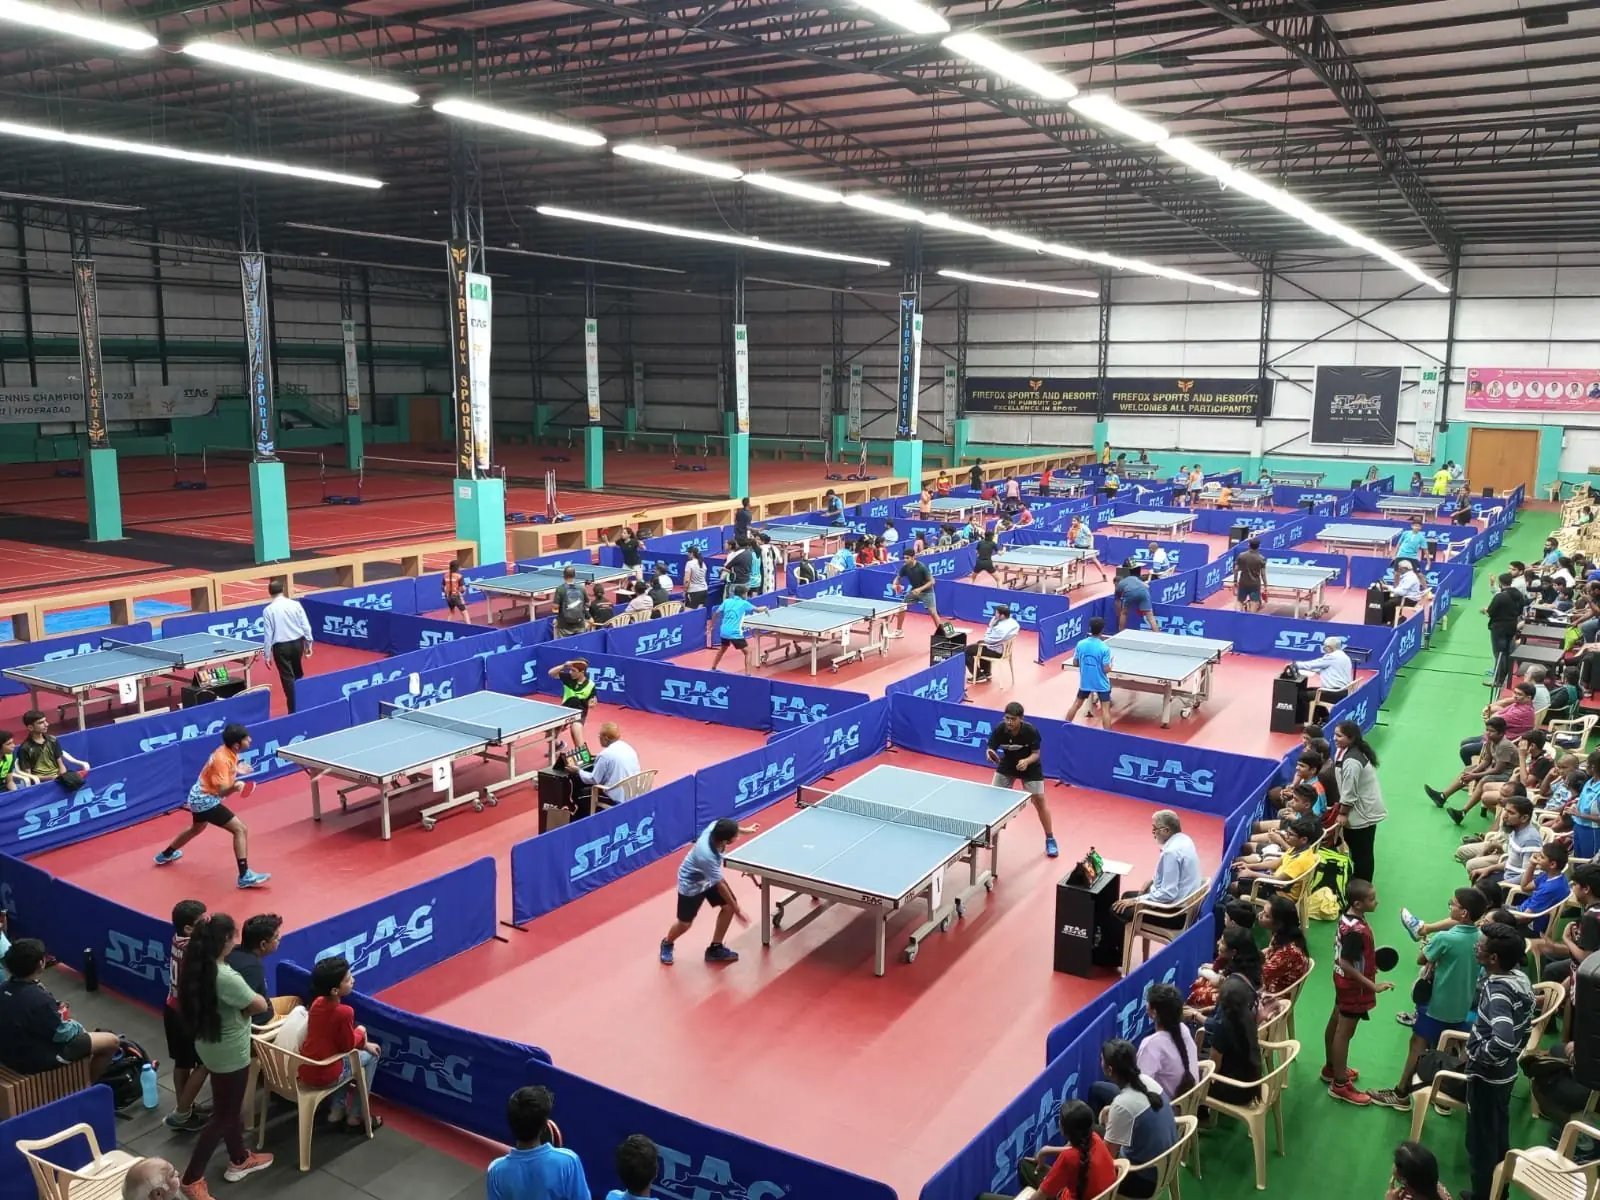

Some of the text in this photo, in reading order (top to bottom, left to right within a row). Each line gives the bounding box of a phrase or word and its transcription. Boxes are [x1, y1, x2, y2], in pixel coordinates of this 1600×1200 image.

[457, 270, 472, 454] FIREFOX SPORTS
[0, 394, 30, 402] ENNIS
[89, 368, 101, 429] SPORTS
[257, 372, 268, 440] SPORTS
[972, 391, 1005, 399] FIREFOX
[1008, 391, 1040, 400] SPORTS
[1043, 392, 1060, 400] AND
[1112, 393, 1150, 401] FIREFOX
[1153, 393, 1190, 402] SPORTS
[1192, 394, 1213, 402] AND
[14, 406, 71, 414] HYDERABAD
[1120, 403, 1252, 413] WELCOMES ALL PARTICIPANTS
[929, 558, 955, 576] STAG
[1161, 581, 1187, 604] STAG
[983, 601, 1037, 623] SAG
[323, 616, 368, 639] STAG
[1055, 616, 1083, 644] STAG
[636, 628, 682, 655] STAG
[125, 683, 132, 694] 3
[661, 679, 729, 709] STAG
[772, 695, 827, 724] TAG
[935, 717, 994, 750] STA
[438, 766, 446, 780] 2
[735, 757, 796, 808] STAG
[1113, 754, 1214, 797] STAG
[18, 783, 127, 840] STAG
[570, 815, 654, 881] STAG
[936, 877, 941, 893] 1
[861, 895, 883, 905] STAG
[1061, 924, 1088, 939] STAG
[366, 1026, 473, 1102] TAG
